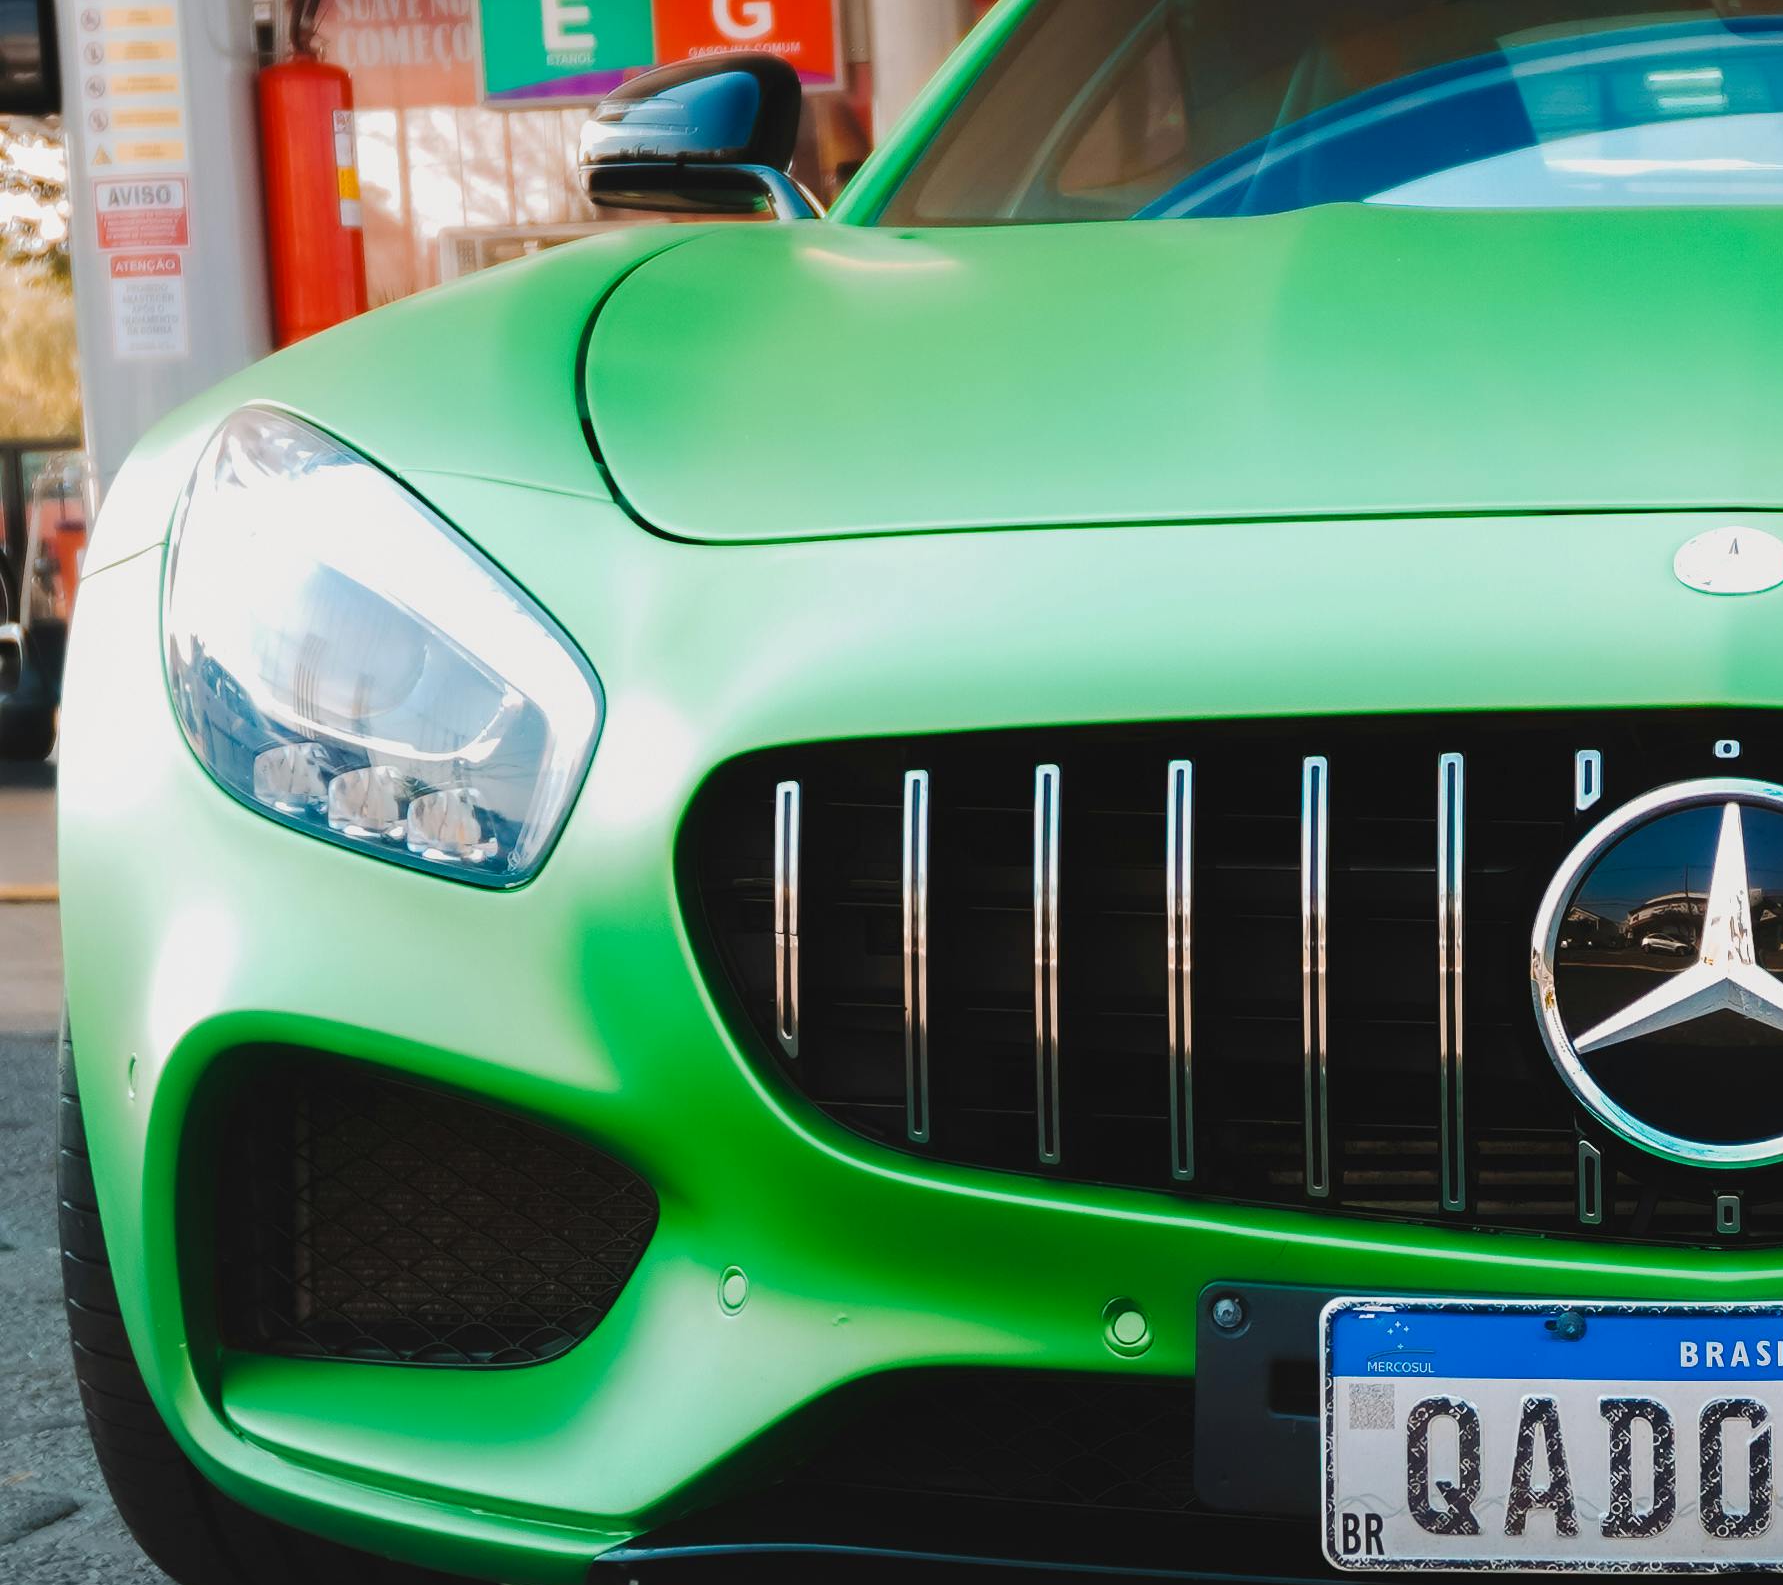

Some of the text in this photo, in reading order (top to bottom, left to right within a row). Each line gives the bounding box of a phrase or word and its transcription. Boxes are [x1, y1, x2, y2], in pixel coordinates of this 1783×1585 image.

[546, 52, 596, 66] ETANOL
[107, 183, 172, 207] AVISO
[115, 258, 176, 273] ATENÇÃO
[1366, 1360, 1436, 1374] MERCOSUL
[1342, 1512, 1386, 1557] BR
